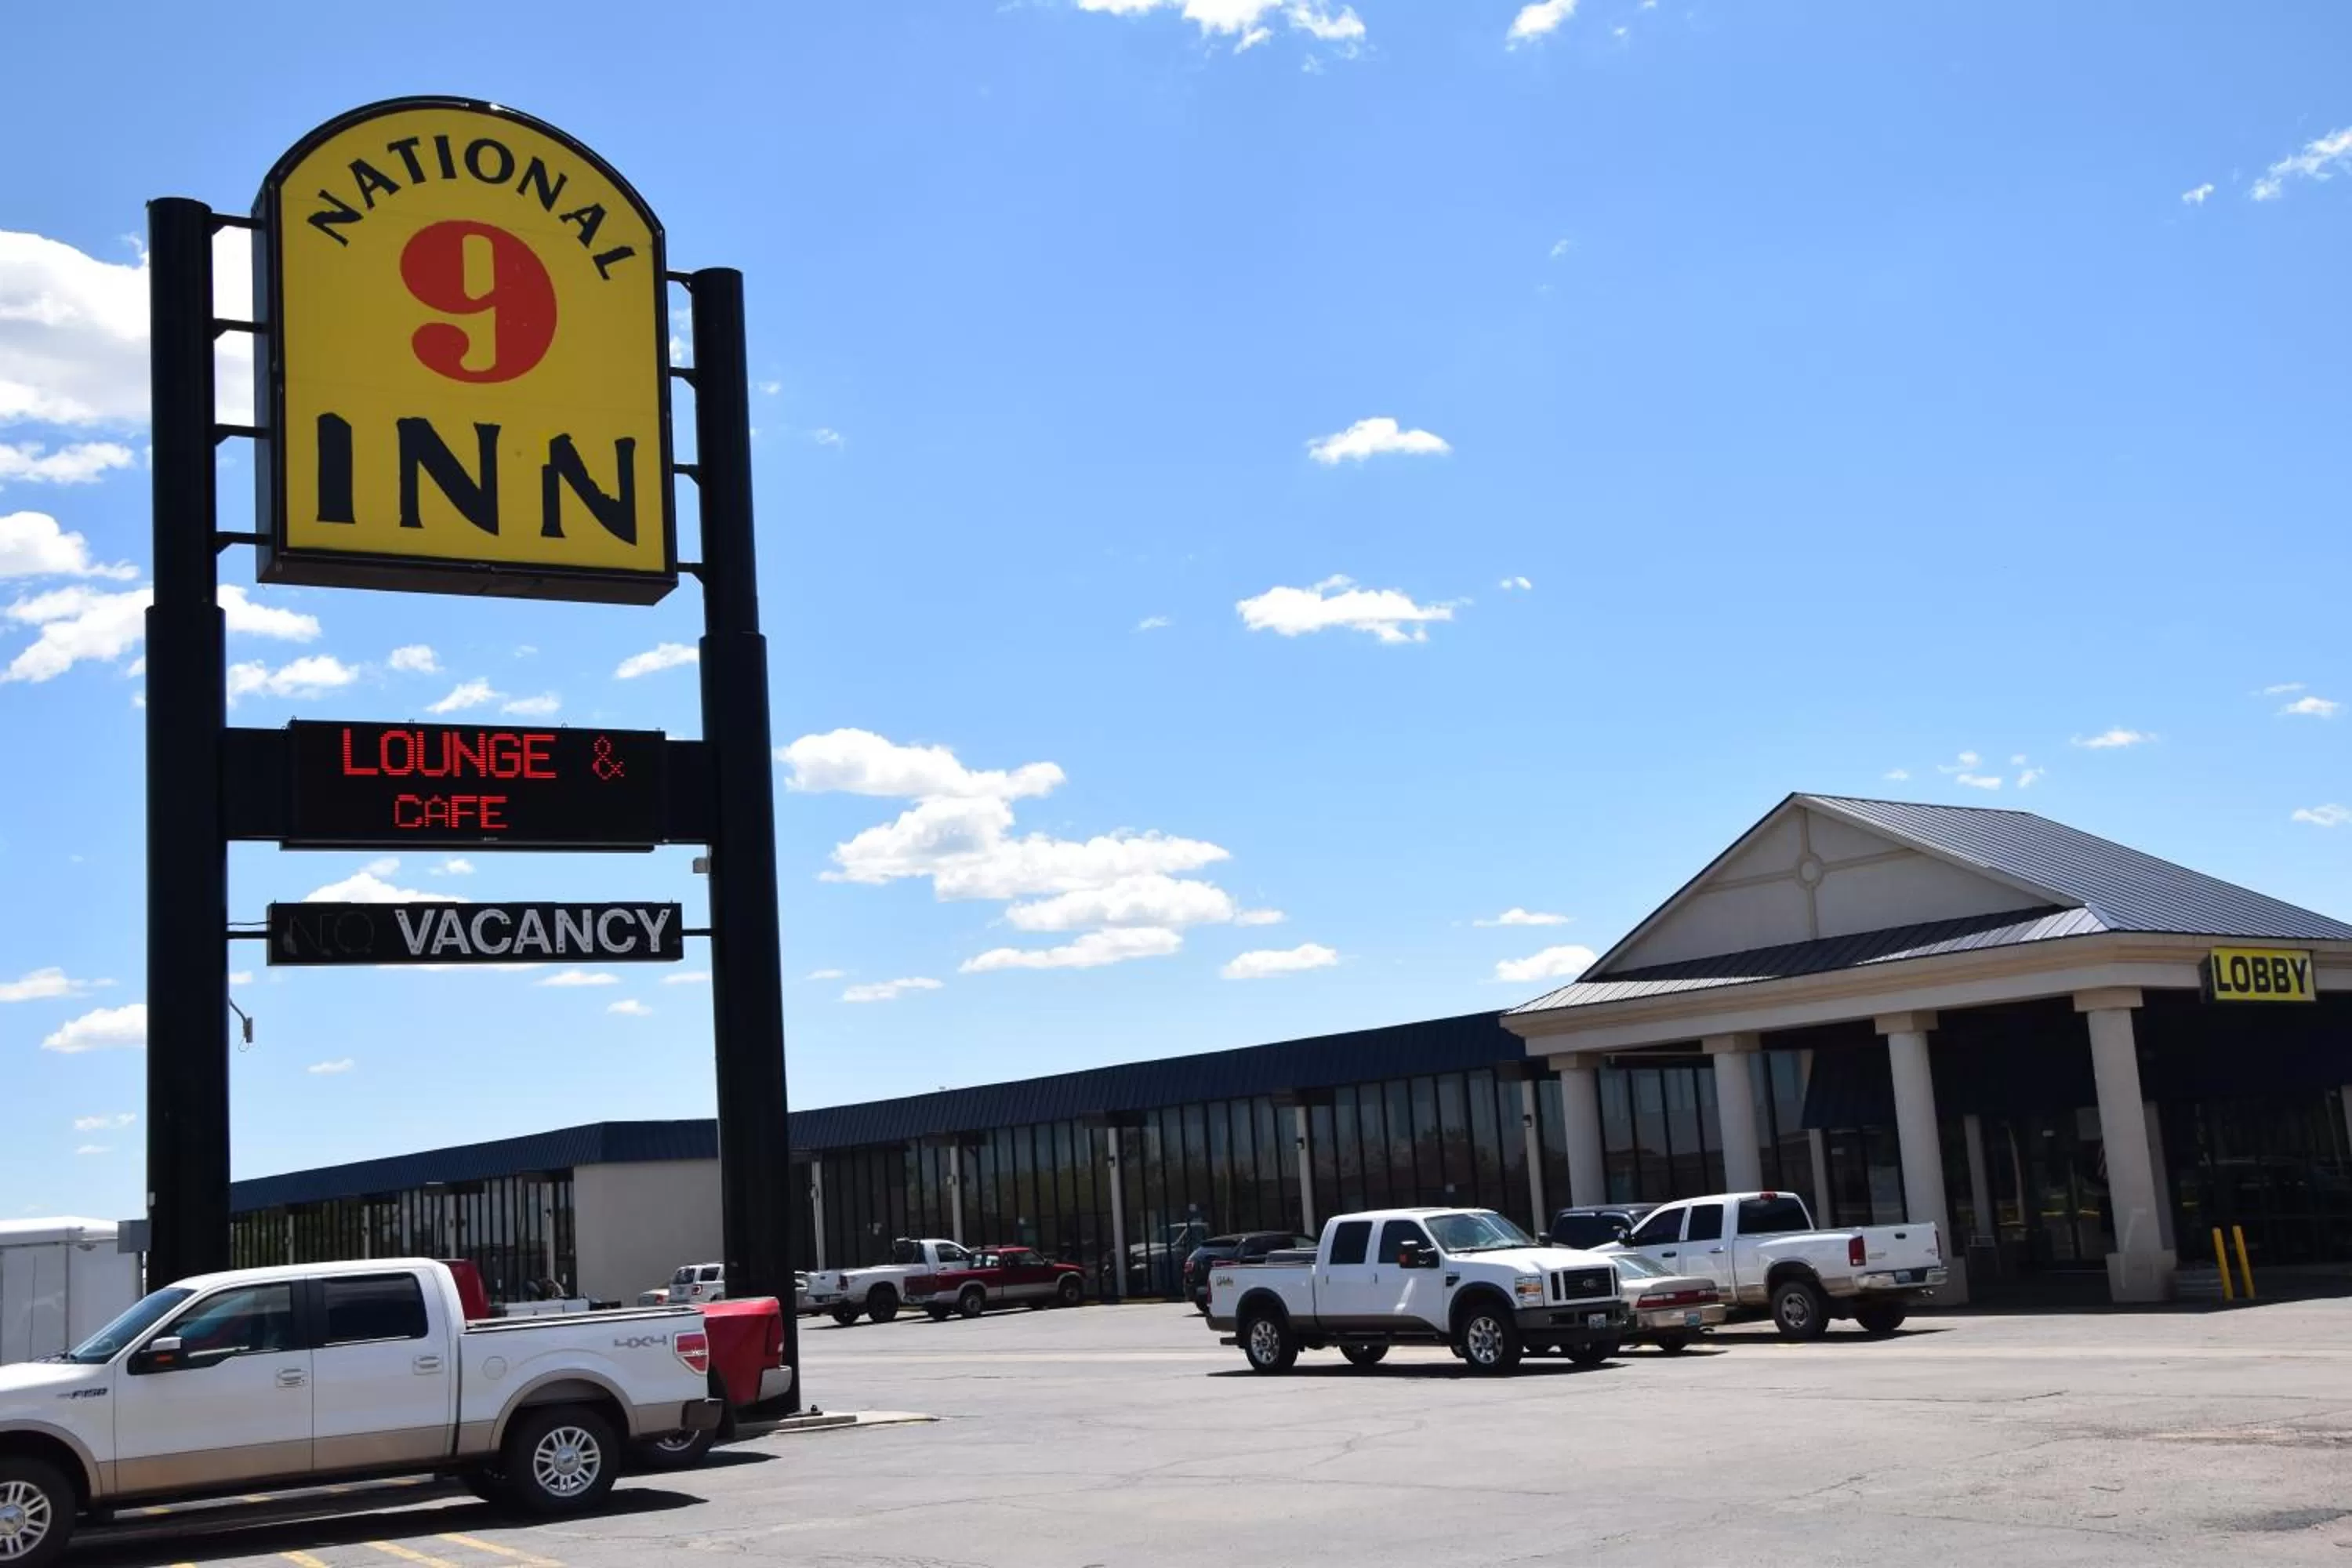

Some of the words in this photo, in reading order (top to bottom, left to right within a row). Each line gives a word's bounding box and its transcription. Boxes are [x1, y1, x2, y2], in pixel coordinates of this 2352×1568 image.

[307, 135, 636, 281] NATIONAL
[399, 220, 557, 384] 9
[316, 412, 637, 546] INN
[342, 728, 557, 779] LOUNGE
[592, 735, 626, 780] &
[394, 793, 509, 829] CAFE
[394, 908, 671, 956] VACANCY
[2213, 954, 2308, 994] LOBBY
